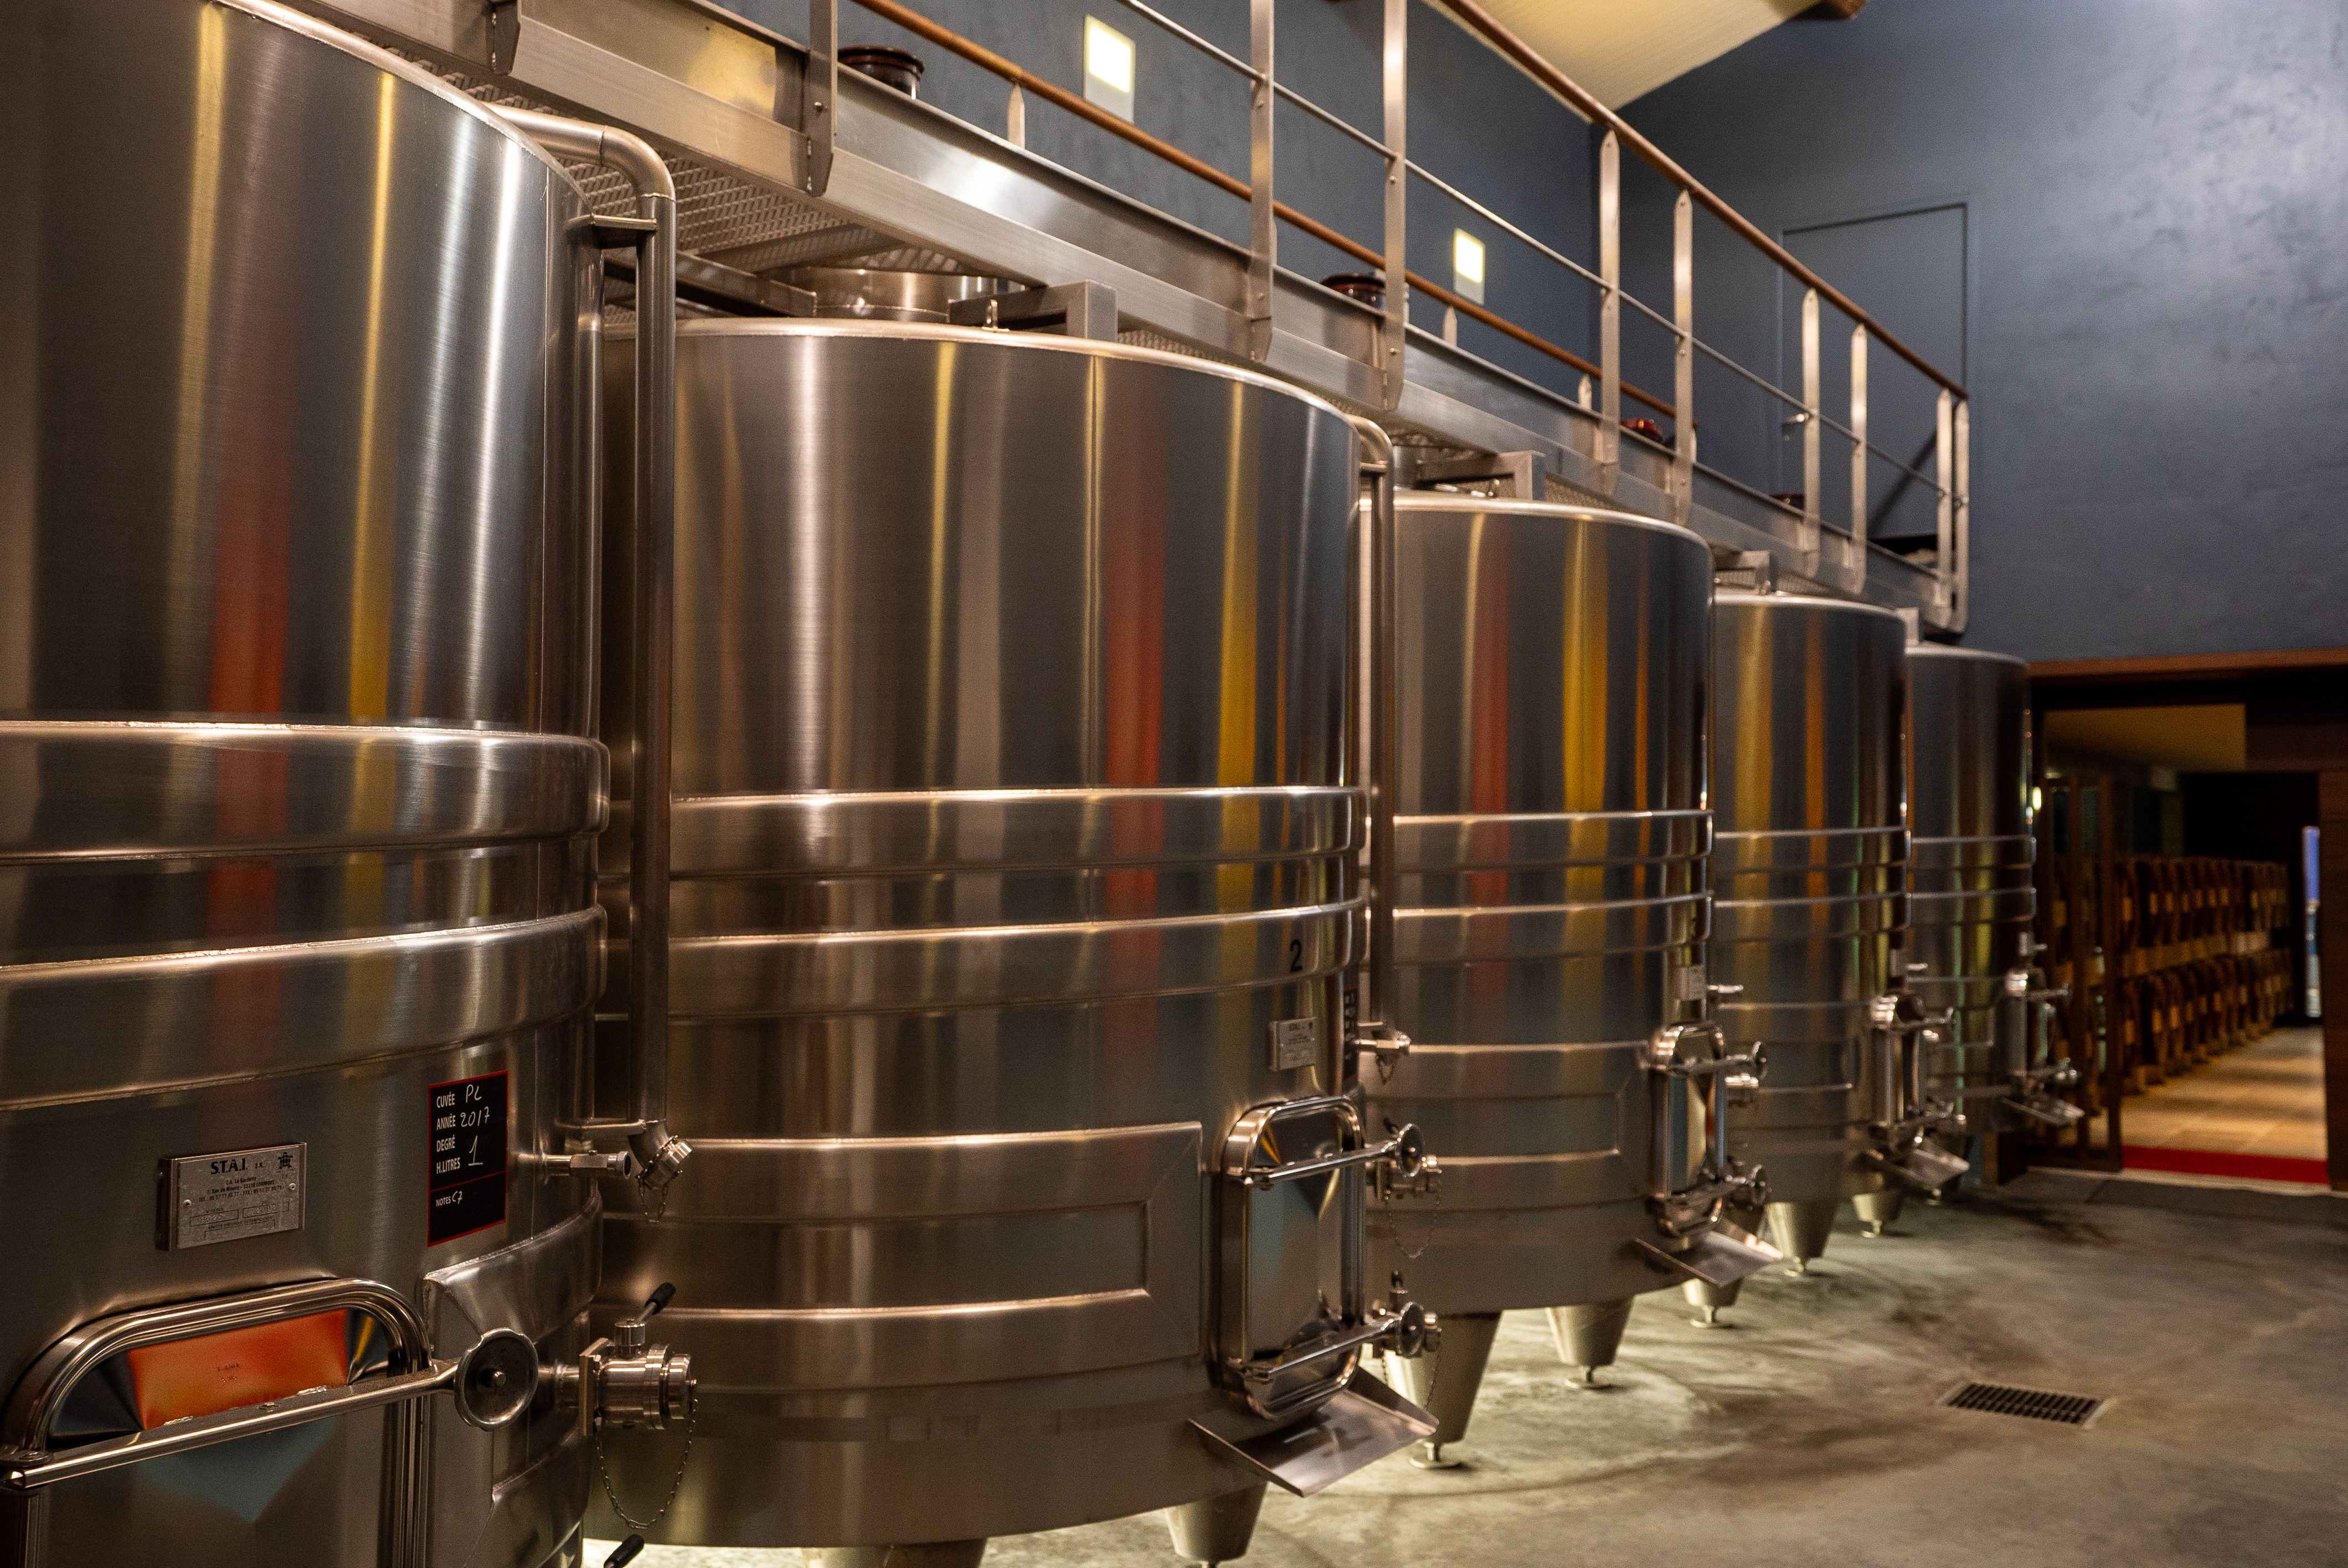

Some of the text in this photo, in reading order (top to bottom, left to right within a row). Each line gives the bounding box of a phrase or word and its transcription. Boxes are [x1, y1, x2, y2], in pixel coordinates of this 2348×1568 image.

[1290, 939, 1302, 972] 2
[436, 1091, 455, 1108] CUVÉE
[436, 1106, 490, 1131] ANNÉE 2017
[436, 1134, 455, 1152] DEGRÉ
[468, 1135, 483, 1166] 1
[436, 1157, 460, 1174] H.LITRES
[436, 1194, 451, 1207] NOTES
